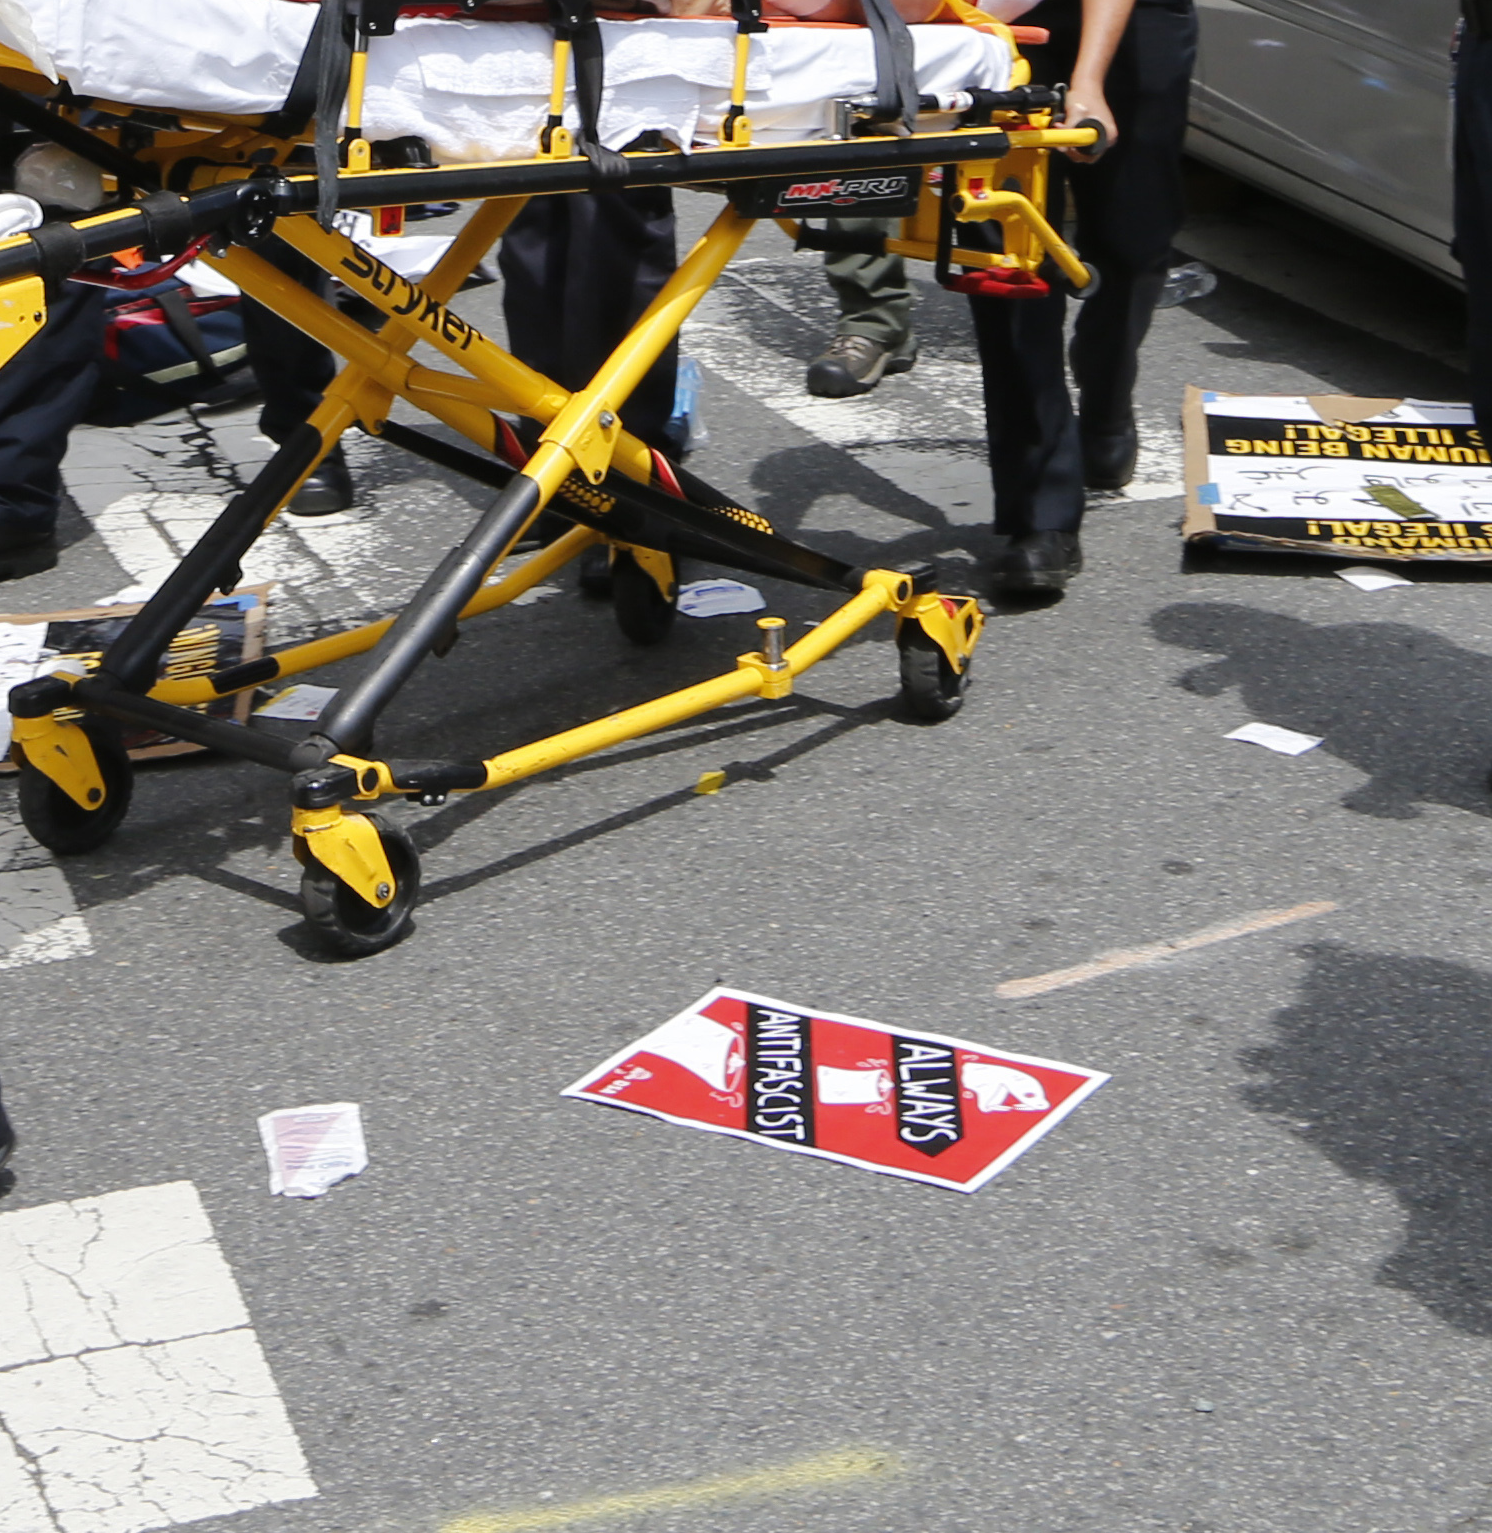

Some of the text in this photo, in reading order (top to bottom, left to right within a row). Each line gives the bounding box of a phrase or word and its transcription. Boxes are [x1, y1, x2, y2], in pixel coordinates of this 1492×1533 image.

[784, 176, 909, 199] MX-PRO
[1284, 424, 1455, 445] ILLEGAL!
[1225, 438, 1349, 456] BEING
[1306, 519, 1469, 538] ILEGAL!
[753, 1008, 807, 1141] ANTIFASCIST
[898, 1042, 959, 1145] ALWAYS
